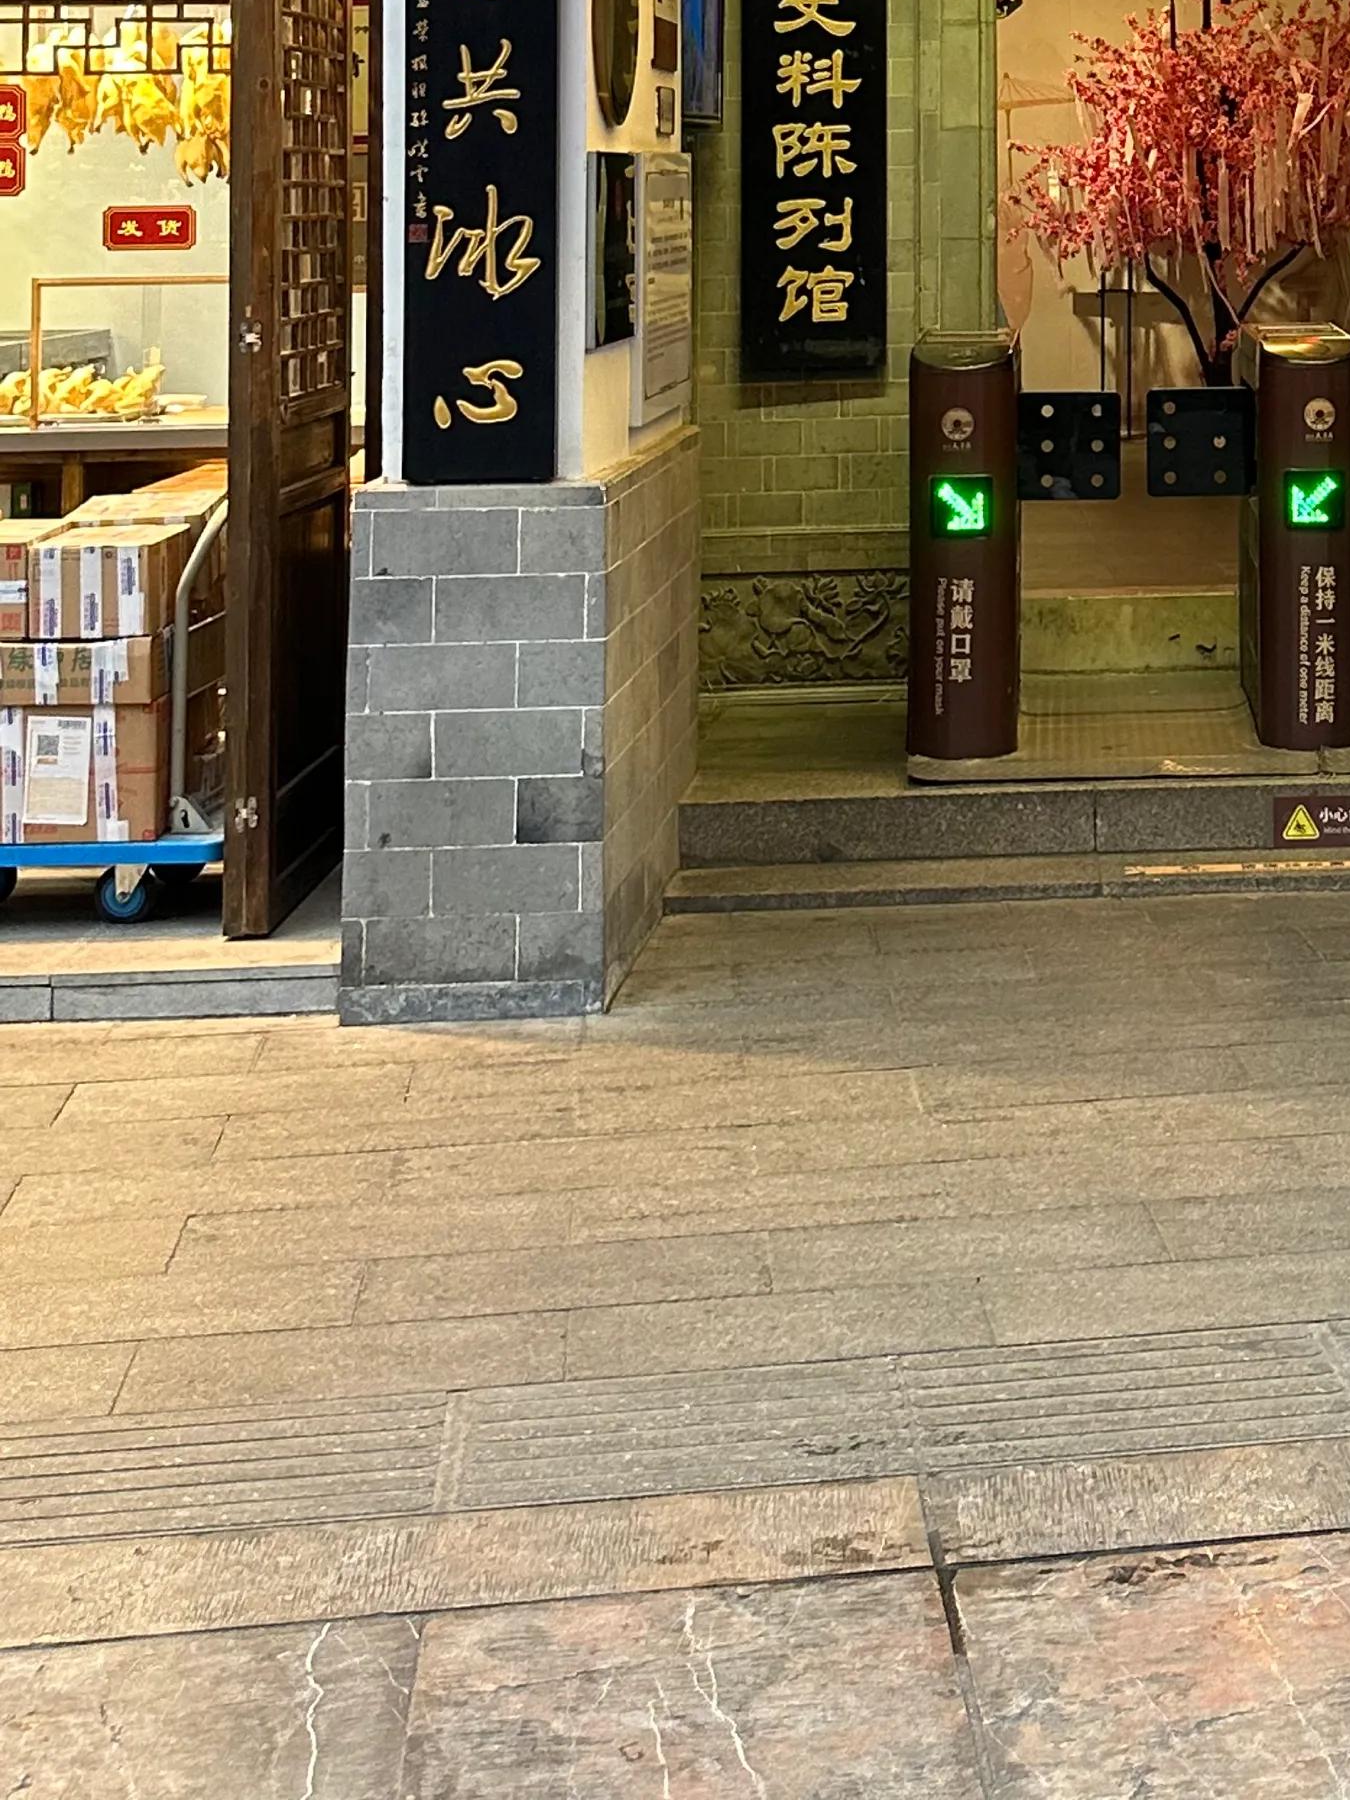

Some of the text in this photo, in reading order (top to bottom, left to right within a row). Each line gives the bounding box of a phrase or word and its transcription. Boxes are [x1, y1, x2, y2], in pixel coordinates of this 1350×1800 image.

[117, 219, 182, 237] 发货
[948, 578, 975, 683] 请戴口罩
[1314, 565, 1337, 724] 保持一米线距离
